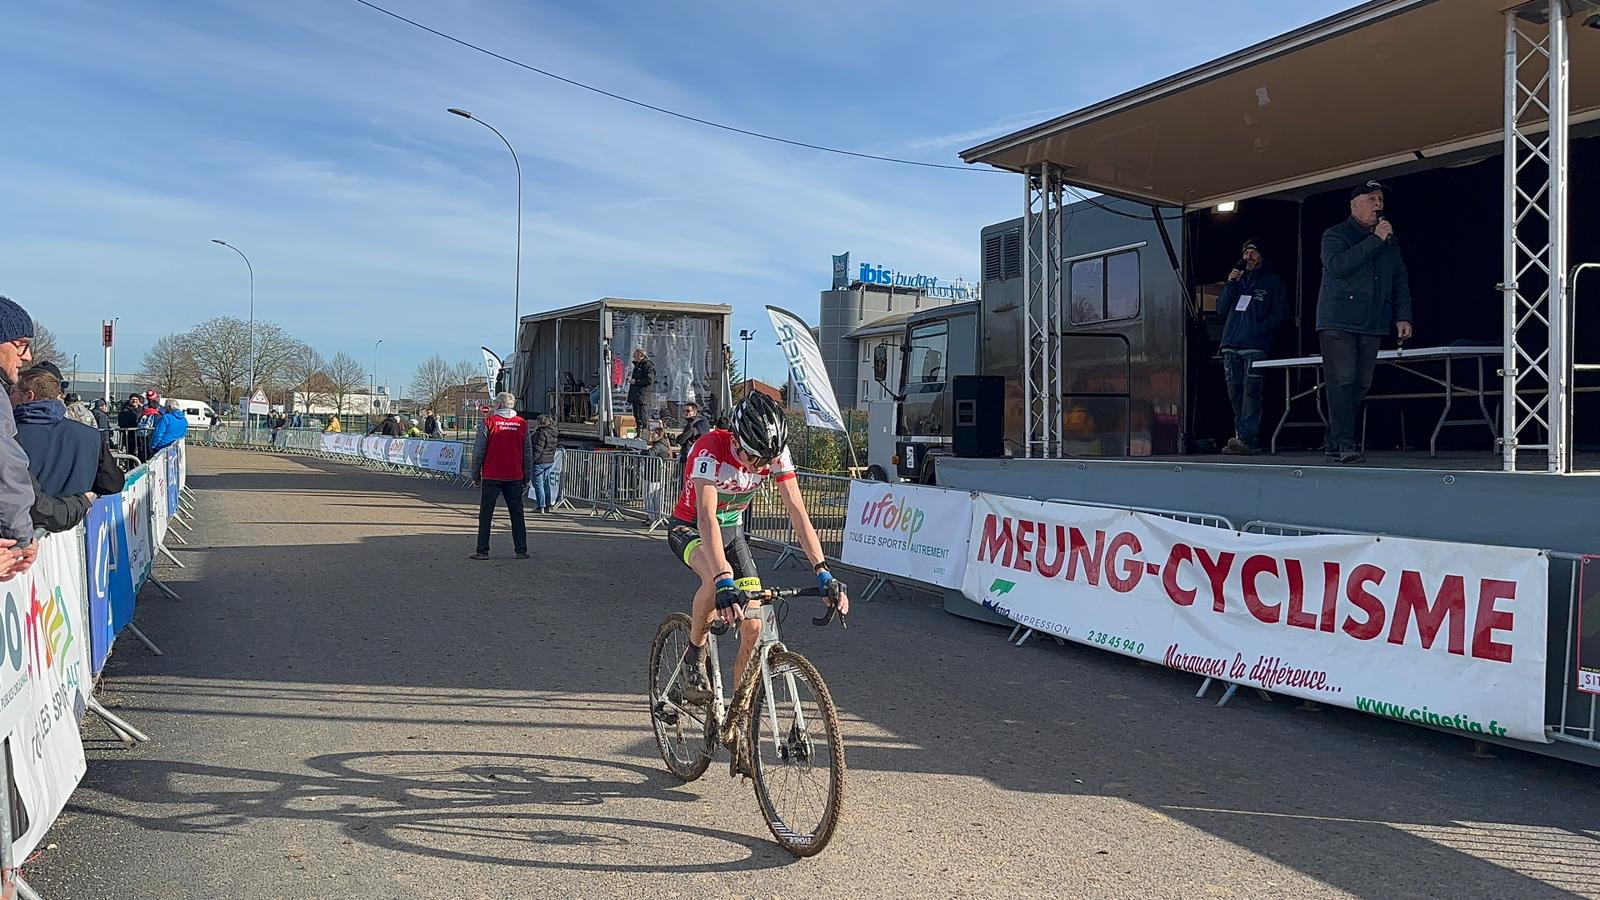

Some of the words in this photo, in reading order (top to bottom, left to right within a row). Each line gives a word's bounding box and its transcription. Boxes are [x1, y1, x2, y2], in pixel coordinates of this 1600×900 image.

[860, 262, 892, 285] ibis
[895, 272, 938, 288] budget
[700, 462, 708, 474] 8
[861, 492, 925, 550] ufolep
[849, 531, 863, 543] TOUS
[863, 533, 877, 546] LES
[877, 536, 907, 551] SPORTS
[910, 542, 950, 560] AUTREMENT
[977, 513, 1518, 664] MEUNG-CYCLISME
[1013, 611, 1071, 635] IMPRESSION
[1087, 630, 1095, 641] 2
[1095, 631, 1108, 645] 38
[1108, 636, 1122, 649] 45
[1122, 639, 1136, 652] 94
[1229, 652, 1246, 679] la
